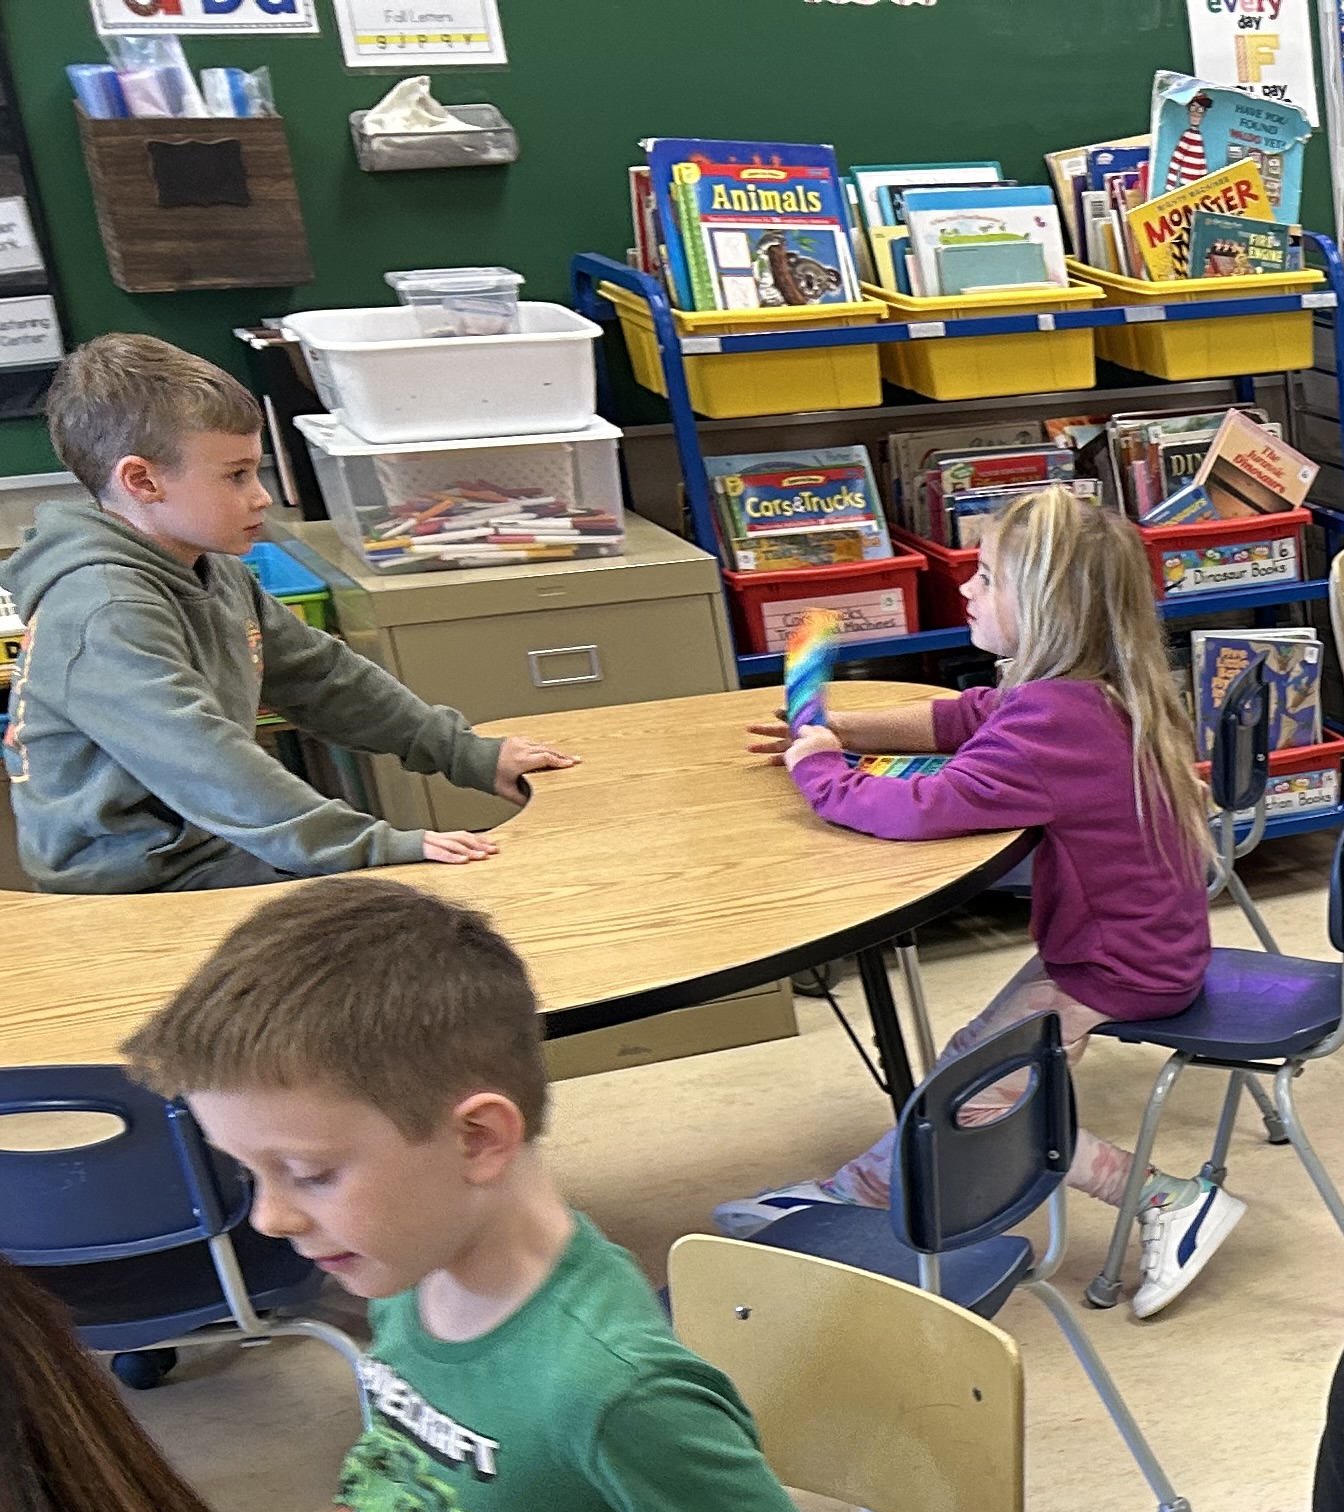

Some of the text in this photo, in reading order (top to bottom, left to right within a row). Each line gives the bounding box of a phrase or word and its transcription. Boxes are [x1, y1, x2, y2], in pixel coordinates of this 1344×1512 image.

[1234, 33, 1281, 83] IF
[711, 183, 822, 214] Animals
[1193, 561, 1288, 586] Dinosaur Books
